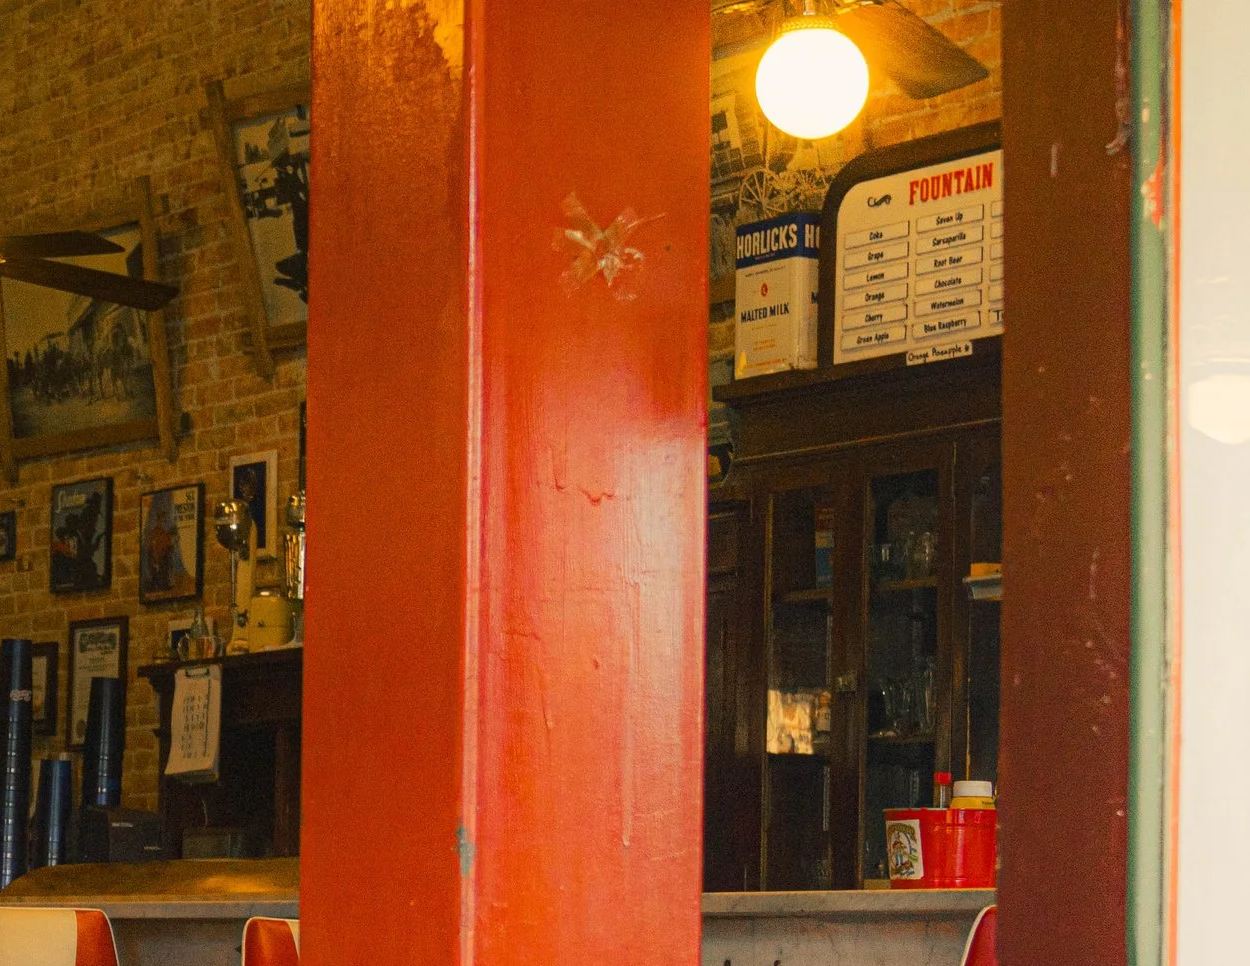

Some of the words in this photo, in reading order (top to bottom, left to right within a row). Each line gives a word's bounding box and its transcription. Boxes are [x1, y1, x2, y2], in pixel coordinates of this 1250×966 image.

[909, 162, 994, 205] FOUNTAIN
[936, 214, 954, 226] Seven
[955, 212, 964, 222] Up
[736, 223, 798, 259] HORLICKS
[869, 231, 883, 240] Coke
[868, 252, 884, 262] Grape
[934, 258, 947, 268] Root
[948, 256, 963, 266] Beer
[866, 272, 884, 282] Lemon
[934, 278, 962, 289] Chocolate
[864, 291, 885, 302] Orange
[930, 298, 964, 310] Watermelon
[741, 307, 768, 322] MALTED
[769, 303, 790, 319] MILK
[864, 313, 883, 323] Cherry
[924, 324, 936, 334] Blue
[938, 318, 967, 332] Raspberry
[856, 335, 872, 344] Green
[874, 332, 889, 343] Apple
